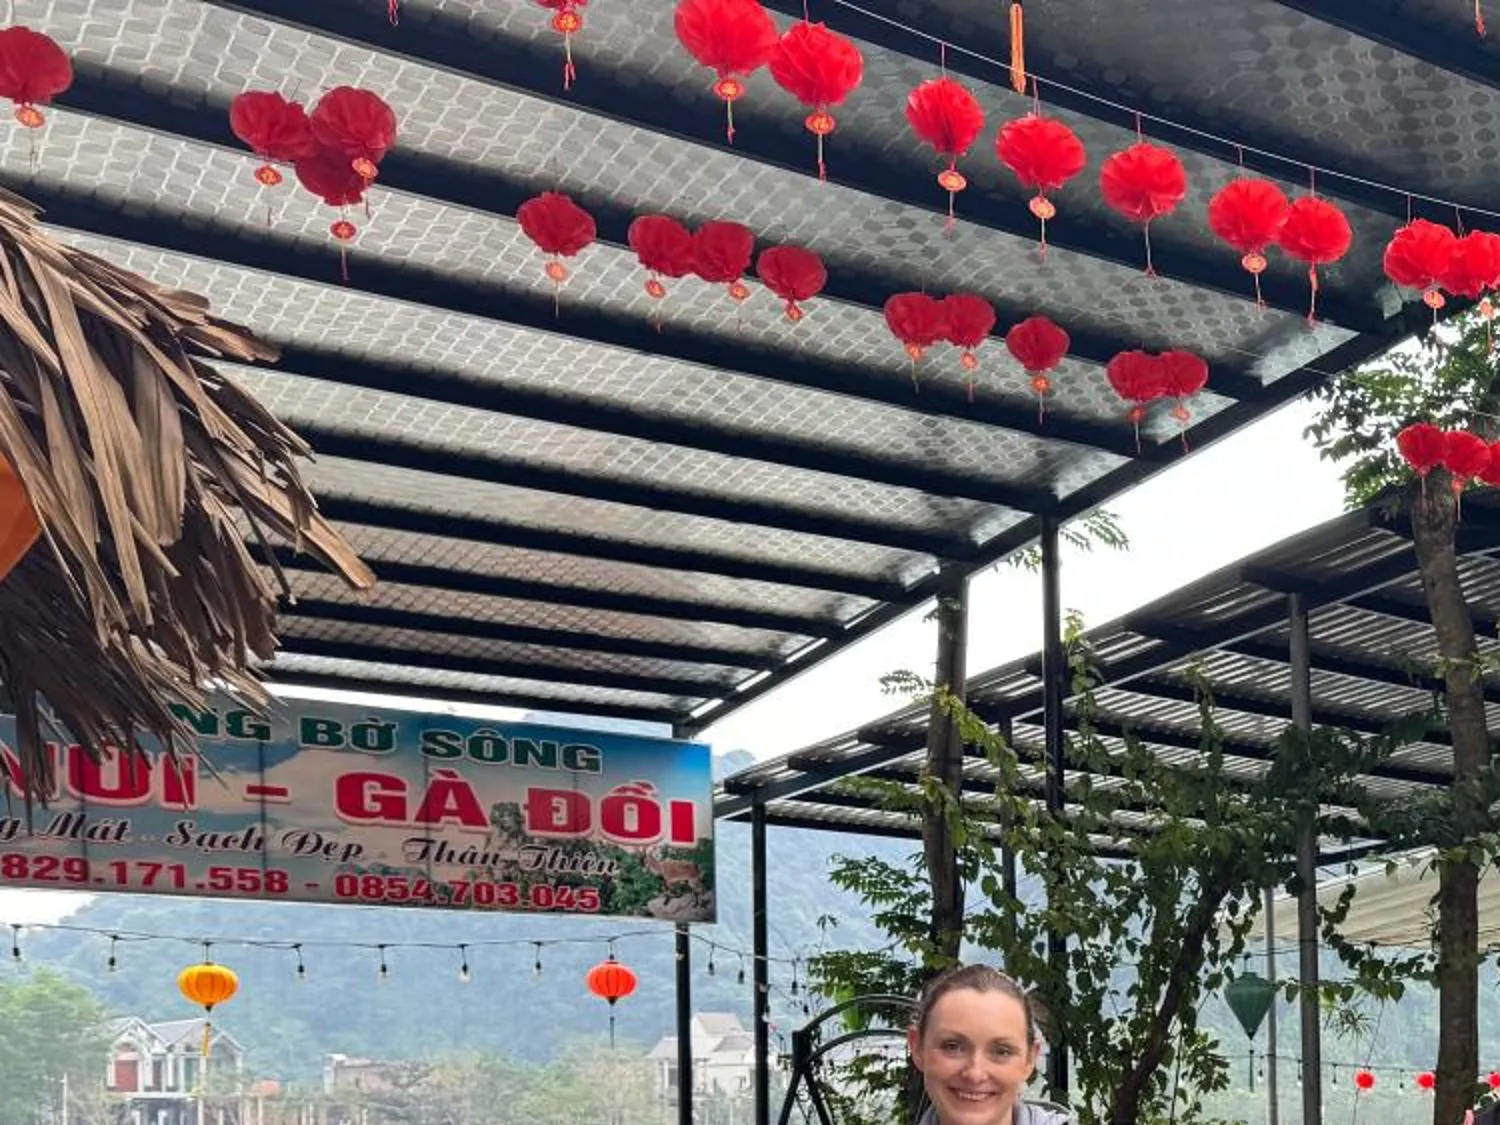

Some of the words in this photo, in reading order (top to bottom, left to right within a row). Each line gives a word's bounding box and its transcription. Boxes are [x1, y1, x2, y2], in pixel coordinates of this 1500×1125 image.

[300, 716, 398, 752] BỜ
[421, 728, 602, 773] SÔNG
[334, 767, 490, 828] GÀ
[523, 781, 697, 844] ĐỒI
[335, 873, 600, 911] 0854.703.045
